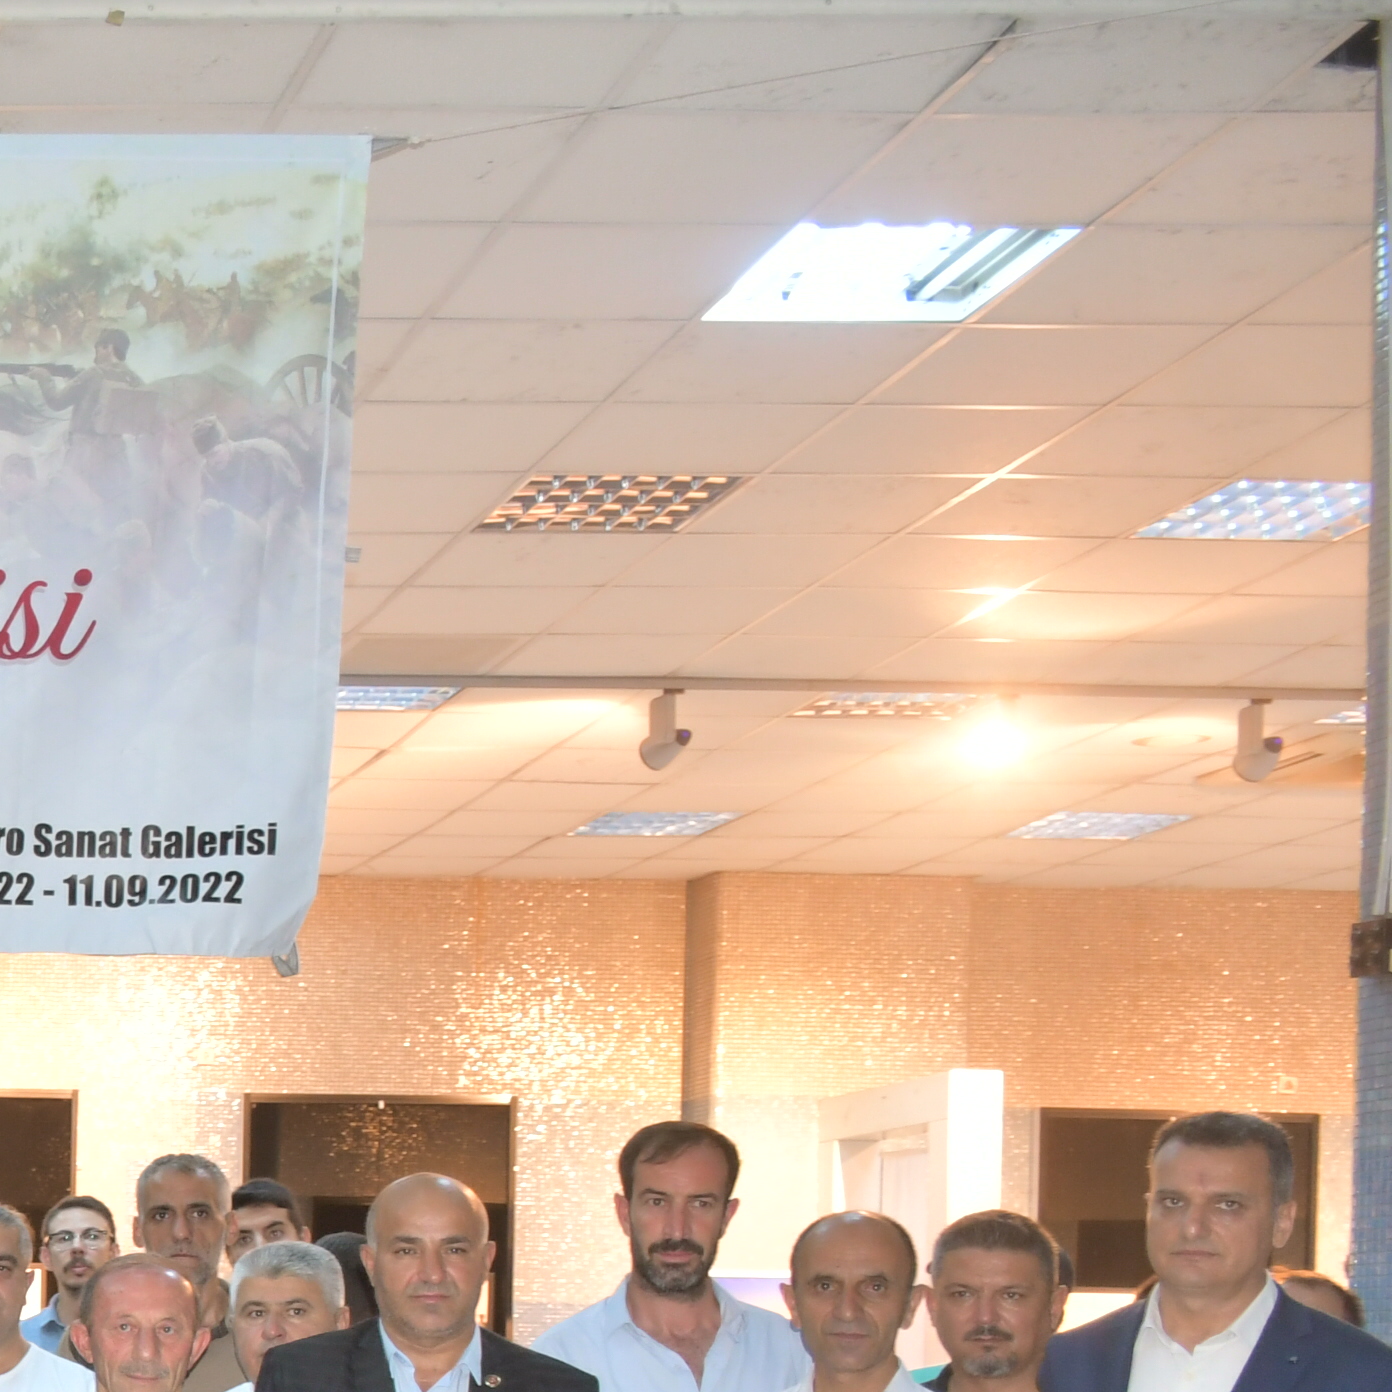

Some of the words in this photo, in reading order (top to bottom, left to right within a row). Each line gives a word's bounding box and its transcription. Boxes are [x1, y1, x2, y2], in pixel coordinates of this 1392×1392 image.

[33, 822, 133, 860] Sanat
[140, 822, 277, 860] Galerisi
[65, 870, 245, 908] 11.09.2022
